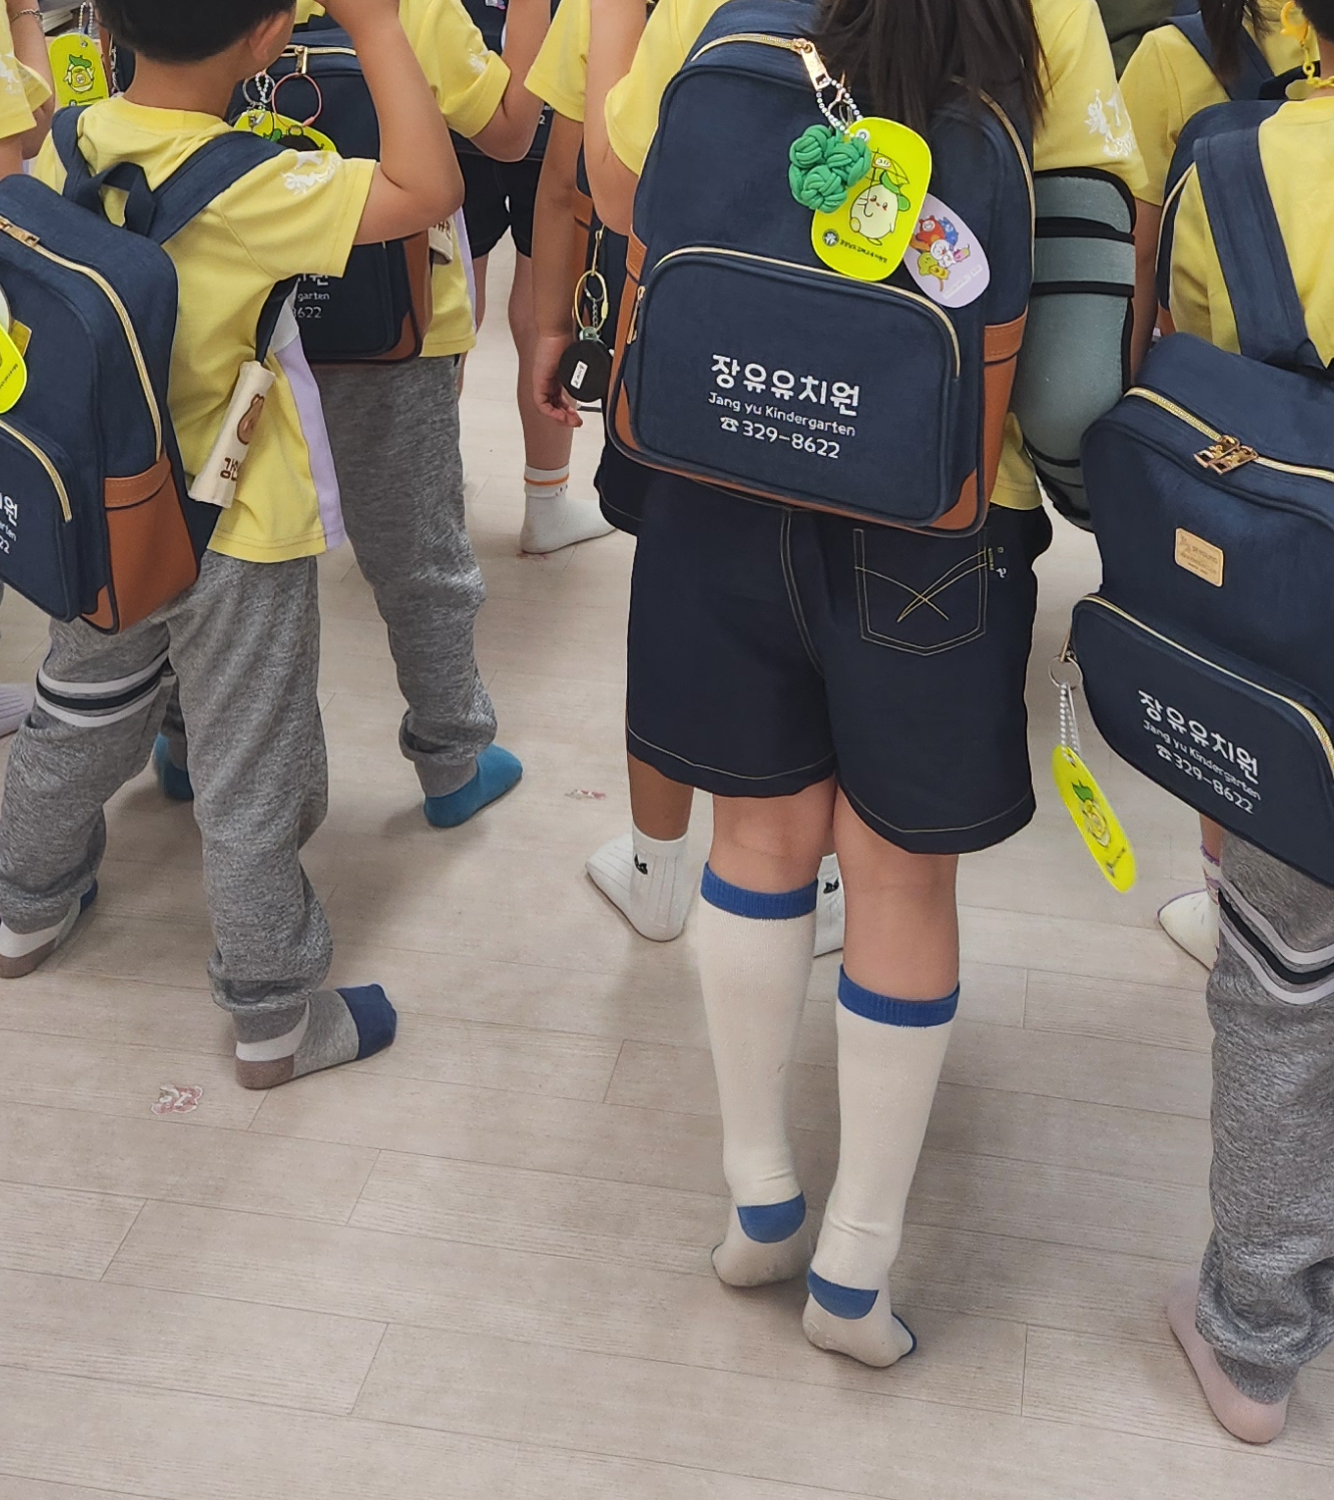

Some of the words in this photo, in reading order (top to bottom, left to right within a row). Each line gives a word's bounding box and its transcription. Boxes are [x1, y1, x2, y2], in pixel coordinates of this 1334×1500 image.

[708, 391, 741, 412] Jang
[744, 402, 762, 415] yu
[765, 405, 856, 437] Kindergarten
[711, 354, 860, 417] 장유유치원
[742, 420, 840, 459] 329-8622
[1138, 690, 1259, 785] 장유유치원
[1143, 719, 1171, 745] Jang
[1173, 738, 1187, 752] yu
[1189, 746, 1261, 801] Kindergarten
[1173, 754, 1255, 816] 329-8622
